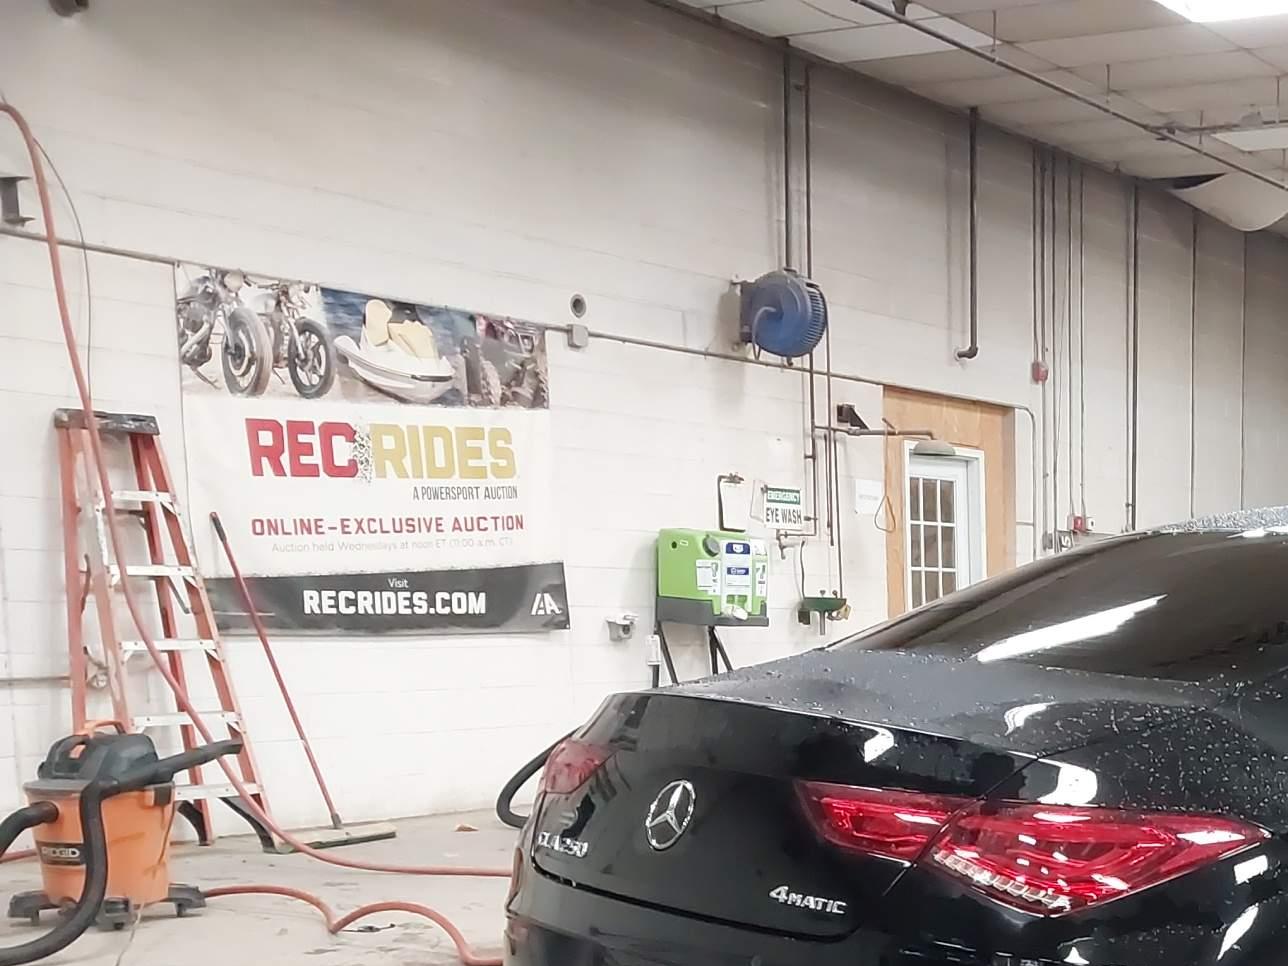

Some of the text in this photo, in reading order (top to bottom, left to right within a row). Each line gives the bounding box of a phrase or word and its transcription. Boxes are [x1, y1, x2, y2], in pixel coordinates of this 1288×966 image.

[245, 418, 518, 479] REC RIDES
[413, 486, 518, 500] A POWERSPORT AUCTION
[766, 507, 802, 524] EYE WASH
[251, 515, 524, 536] ONLINE-EXCLUSIVE AUCTION
[271, 543, 310, 553] Auction
[312, 542, 335, 552] held
[388, 578, 409, 589] Visit
[302, 590, 486, 615] RECRIDES.COM
[769, 885, 847, 914] 4MATIC
